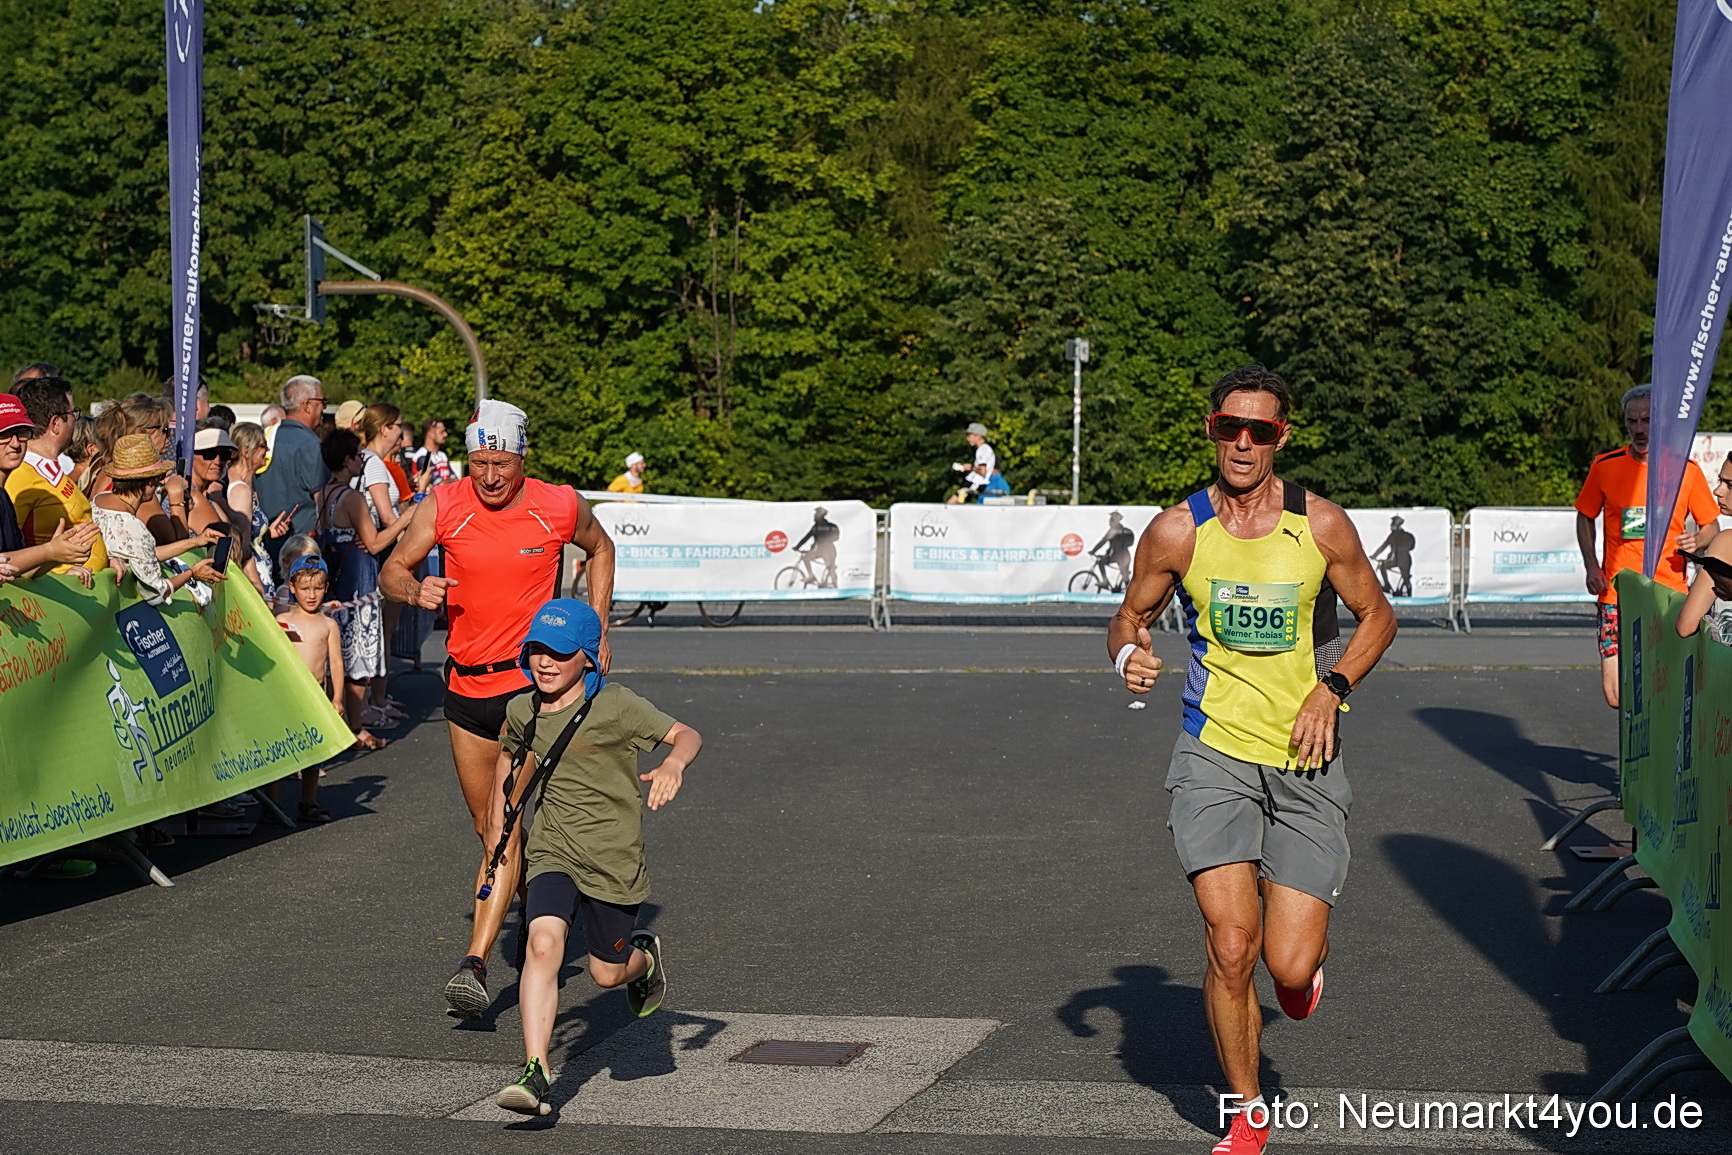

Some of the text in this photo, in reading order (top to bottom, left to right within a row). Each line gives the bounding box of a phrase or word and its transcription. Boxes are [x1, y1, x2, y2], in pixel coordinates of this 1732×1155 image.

[1677, 209, 1732, 419] www.fischer-auto
[614, 524, 650, 536] NOW
[913, 525, 948, 537] NOW
[1493, 531, 1529, 542] NOW
[618, 545, 765, 558] E-BIKES & FAHRRÄDER
[915, 549, 967, 560] E-BIKES
[969, 550, 980, 560] &
[1495, 553, 1544, 563] E-BIKES
[1547, 553, 1556, 563] &
[1214, 610, 1223, 634] RUN
[1224, 604, 1284, 629] 1596
[1285, 610, 1295, 641] 2022
[1223, 627, 1283, 639] Werner Tobias
[134, 627, 166, 652] Fischer
